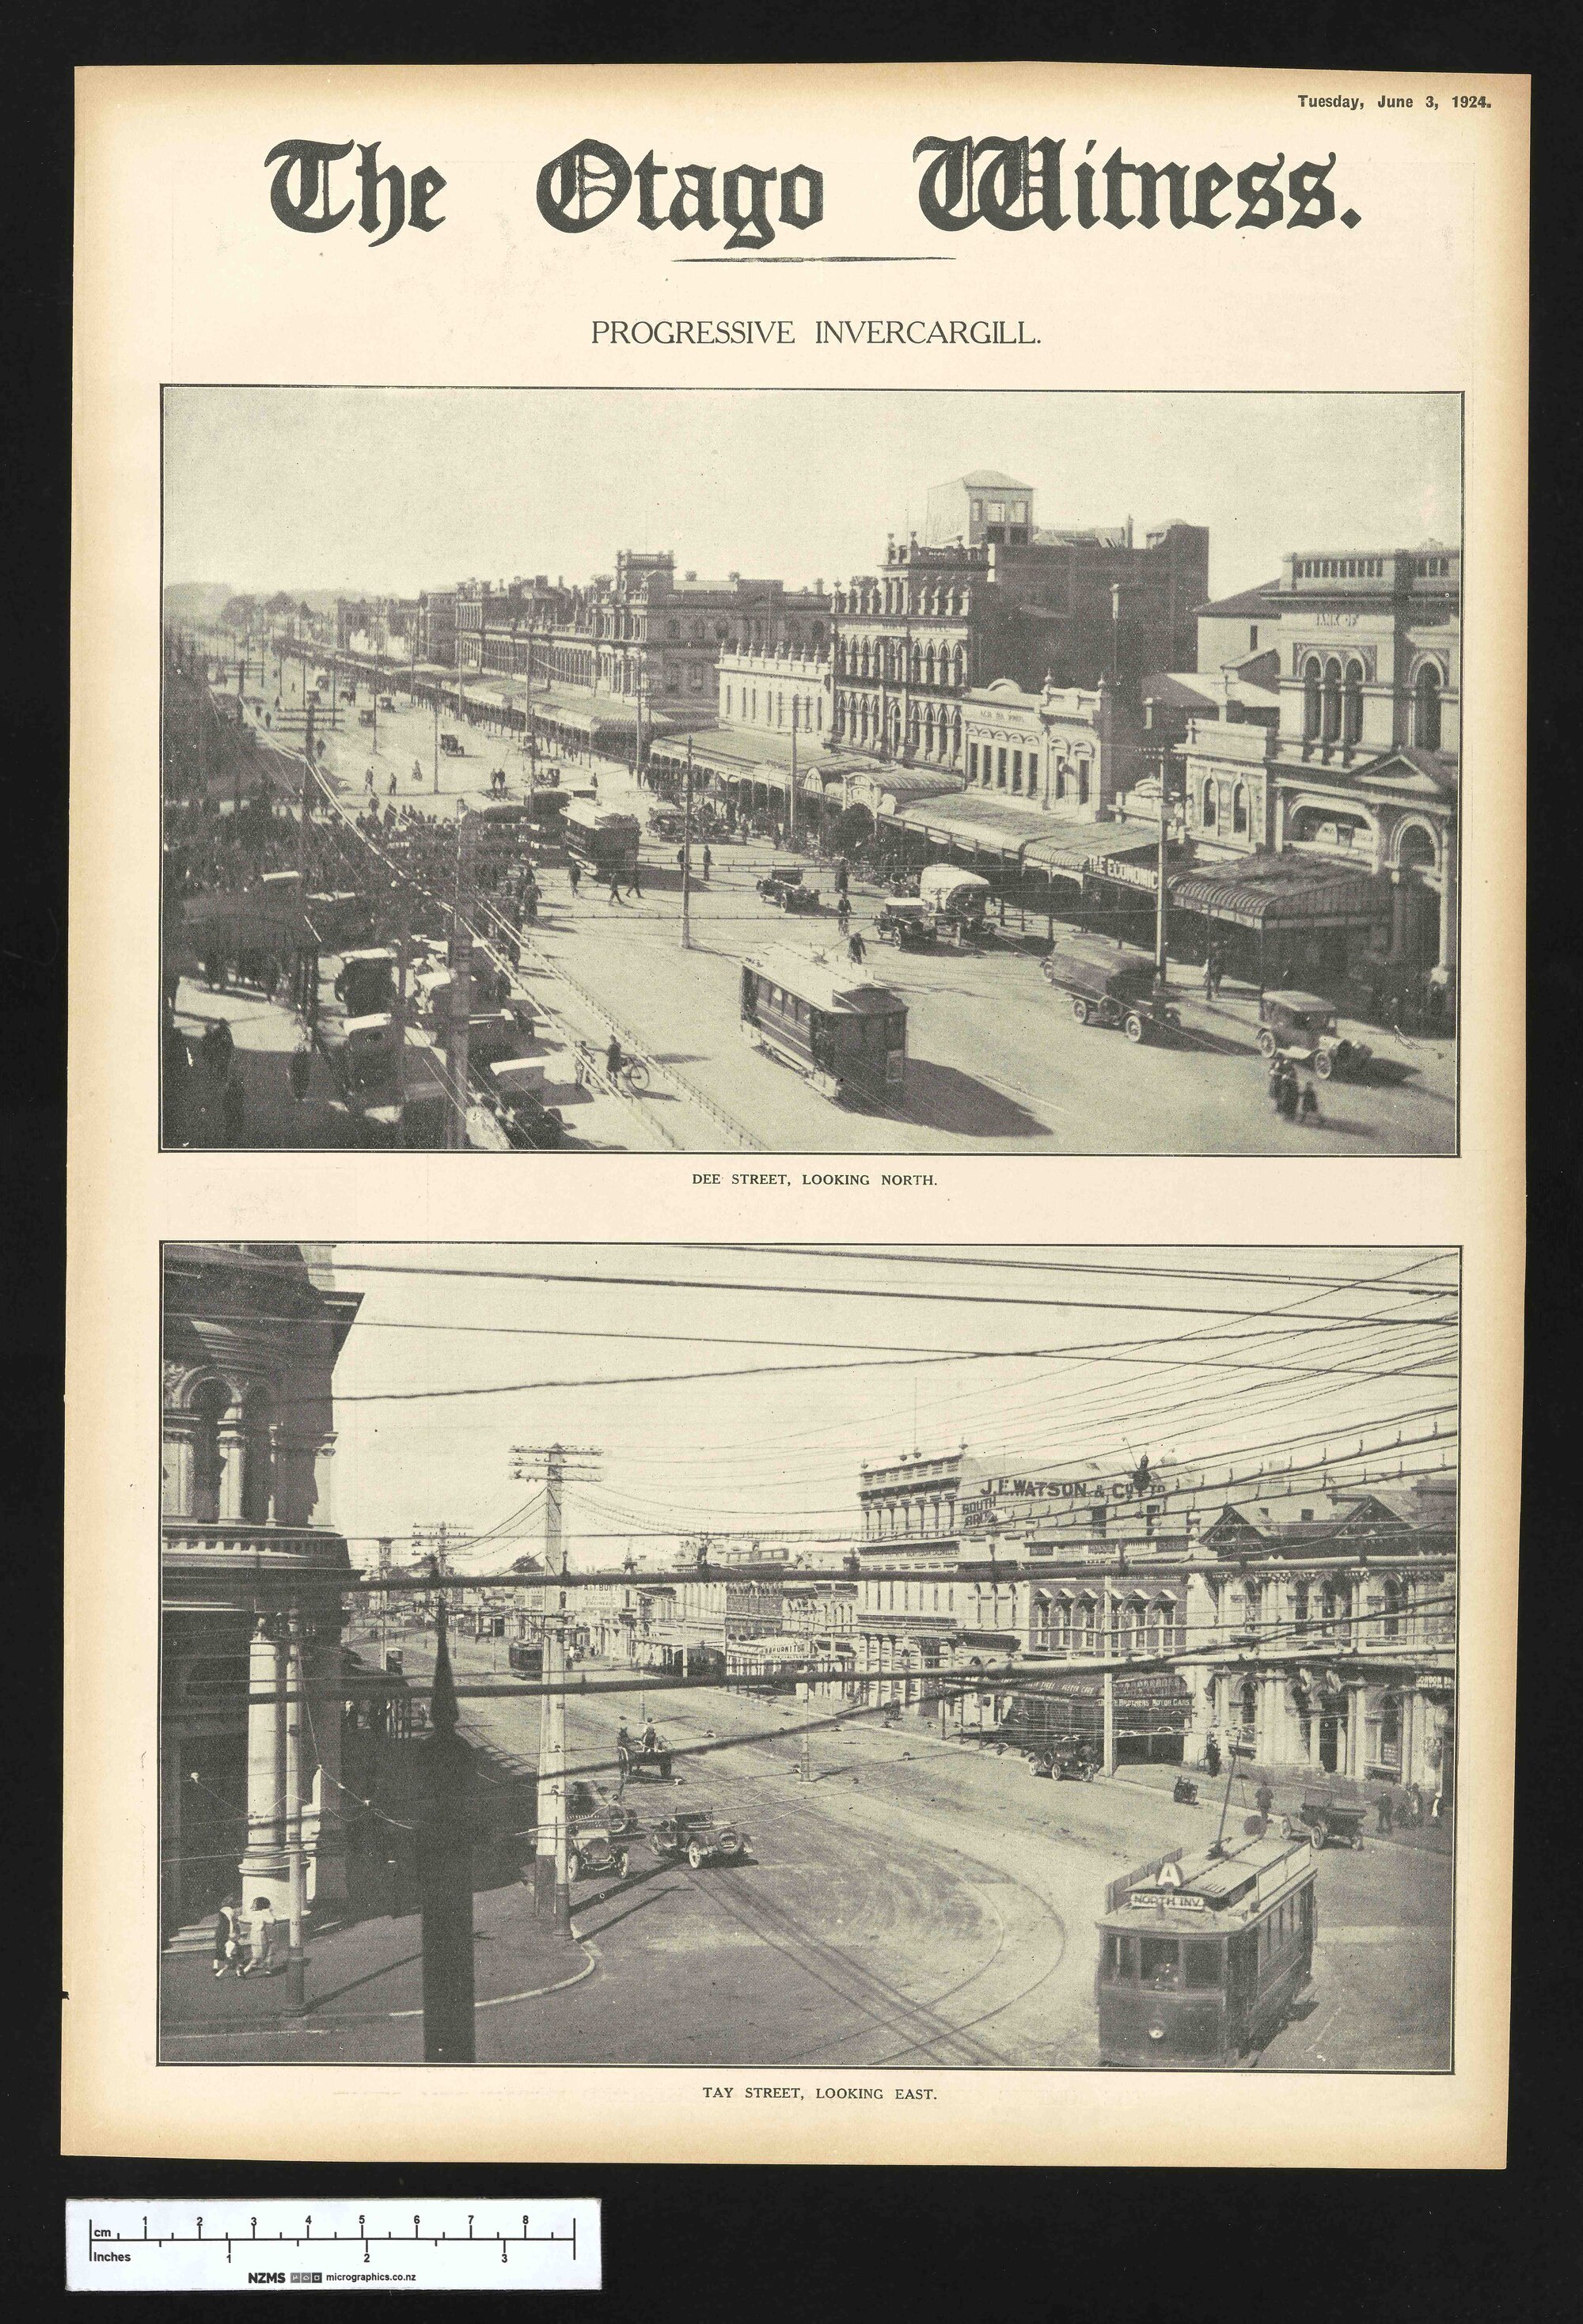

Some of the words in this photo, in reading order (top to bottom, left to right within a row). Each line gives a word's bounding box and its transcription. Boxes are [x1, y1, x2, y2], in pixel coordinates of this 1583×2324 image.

[1297, 94, 1365, 110] Tuesday,
[1377, 95, 1414, 108] June
[1425, 95, 1439, 110] 3,
[1452, 95, 1492, 108] 1924.
[264, 138, 447, 248] The
[536, 138, 824, 250] Otago
[913, 135, 1362, 232] Witness.
[591, 320, 795, 344] PROGRESSIVE
[815, 320, 1041, 344] INVERCARGILL.
[1107, 858, 1158, 889] ECONOMIC
[693, 1173, 721, 1185] DEE
[731, 1173, 791, 1187] STREET,
[802, 1174, 870, 1185] LOOKING
[881, 1174, 937, 1186] NORTH.
[962, 1496, 996, 1515] SOUTH
[773, 1643, 806, 1653] FURNITUR
[1157, 1862, 1181, 1886] A
[702, 2087, 734, 2098] TAY
[745, 2087, 804, 2101] STREET,
[816, 2087, 883, 2099] LOOKING
[895, 2088, 937, 2100] EAST.
[142, 2216, 147, 2225] 1
[196, 2216, 203, 2226] 2
[250, 2216, 257, 2226] 3
[305, 2215, 312, 2224] 4
[359, 2215, 365, 2224] 5
[413, 2215, 420, 2224] 6
[468, 2215, 474, 2224] 7
[522, 2215, 529, 2224] 8
[93, 2229, 112, 2238] cm
[93, 2251, 131, 2262] Inches
[226, 2254, 231, 2263] 1
[363, 2254, 370, 2263] 2
[501, 2254, 508, 2264] 3
[248, 2272, 286, 2284] NZMS
[326, 2273, 416, 2283] micrographics.co.nz
